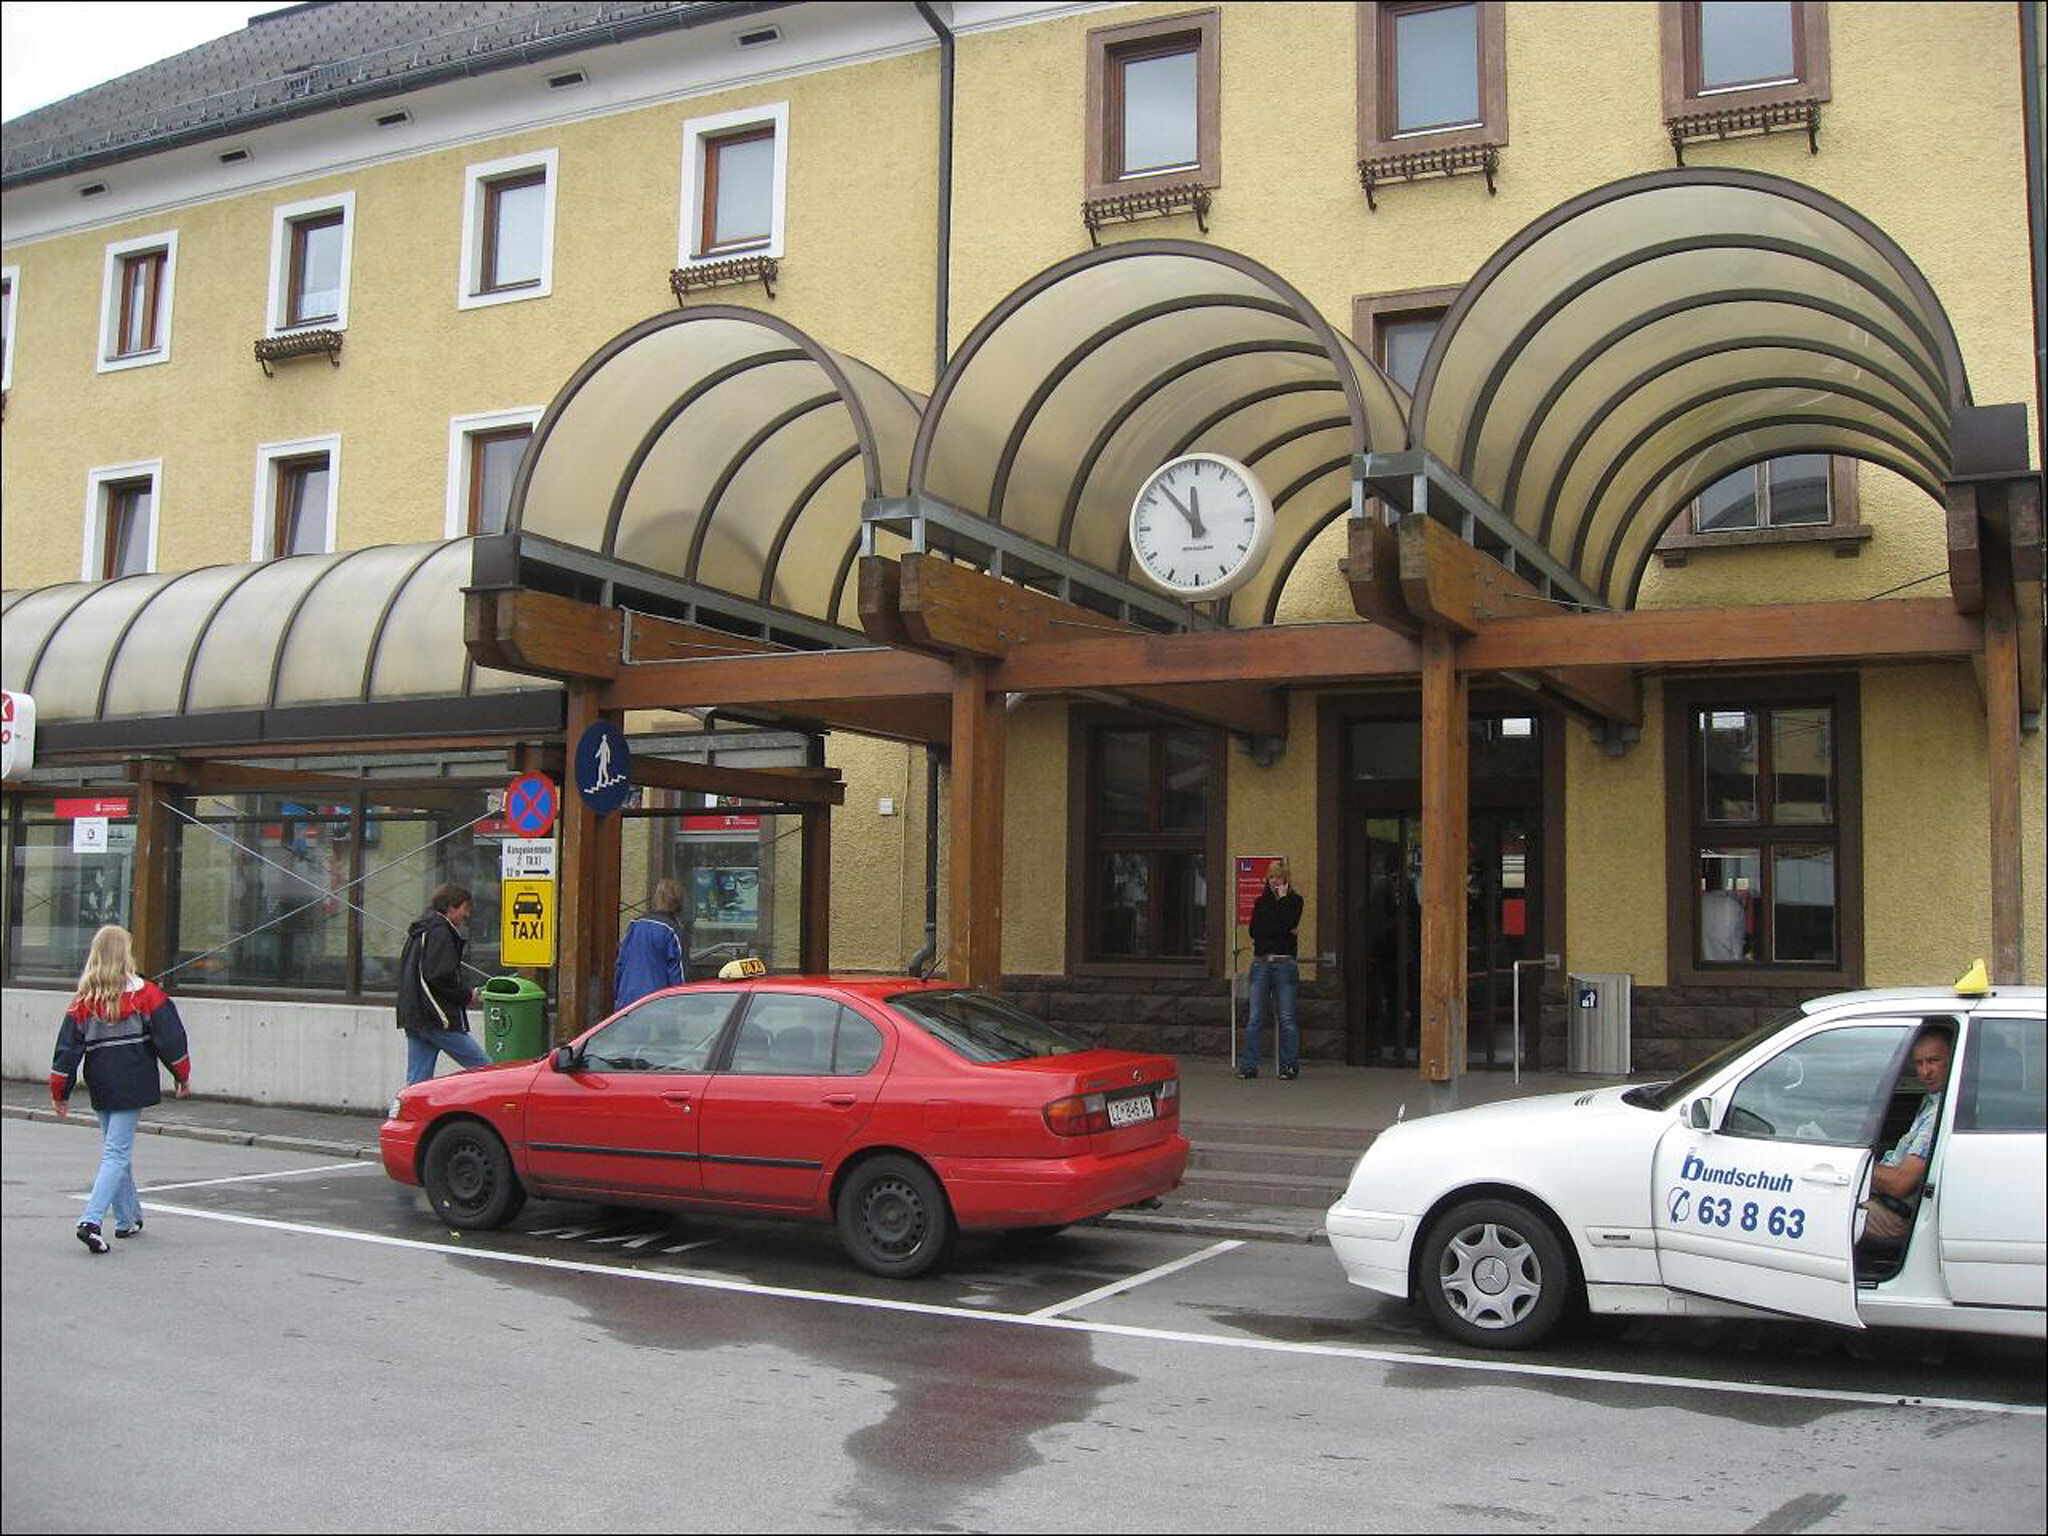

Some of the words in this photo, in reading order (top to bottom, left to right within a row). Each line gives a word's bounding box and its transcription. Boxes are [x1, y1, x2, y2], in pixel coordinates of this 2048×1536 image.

[526, 856, 542, 865] TAXI
[511, 921, 544, 940] TAXI
[740, 960, 764, 975] TAXI
[1681, 1153, 1793, 1192] bundschuh
[1698, 1195, 1732, 1228] 63
[1740, 1202, 1759, 1231] 8
[1768, 1206, 1806, 1239] 63
